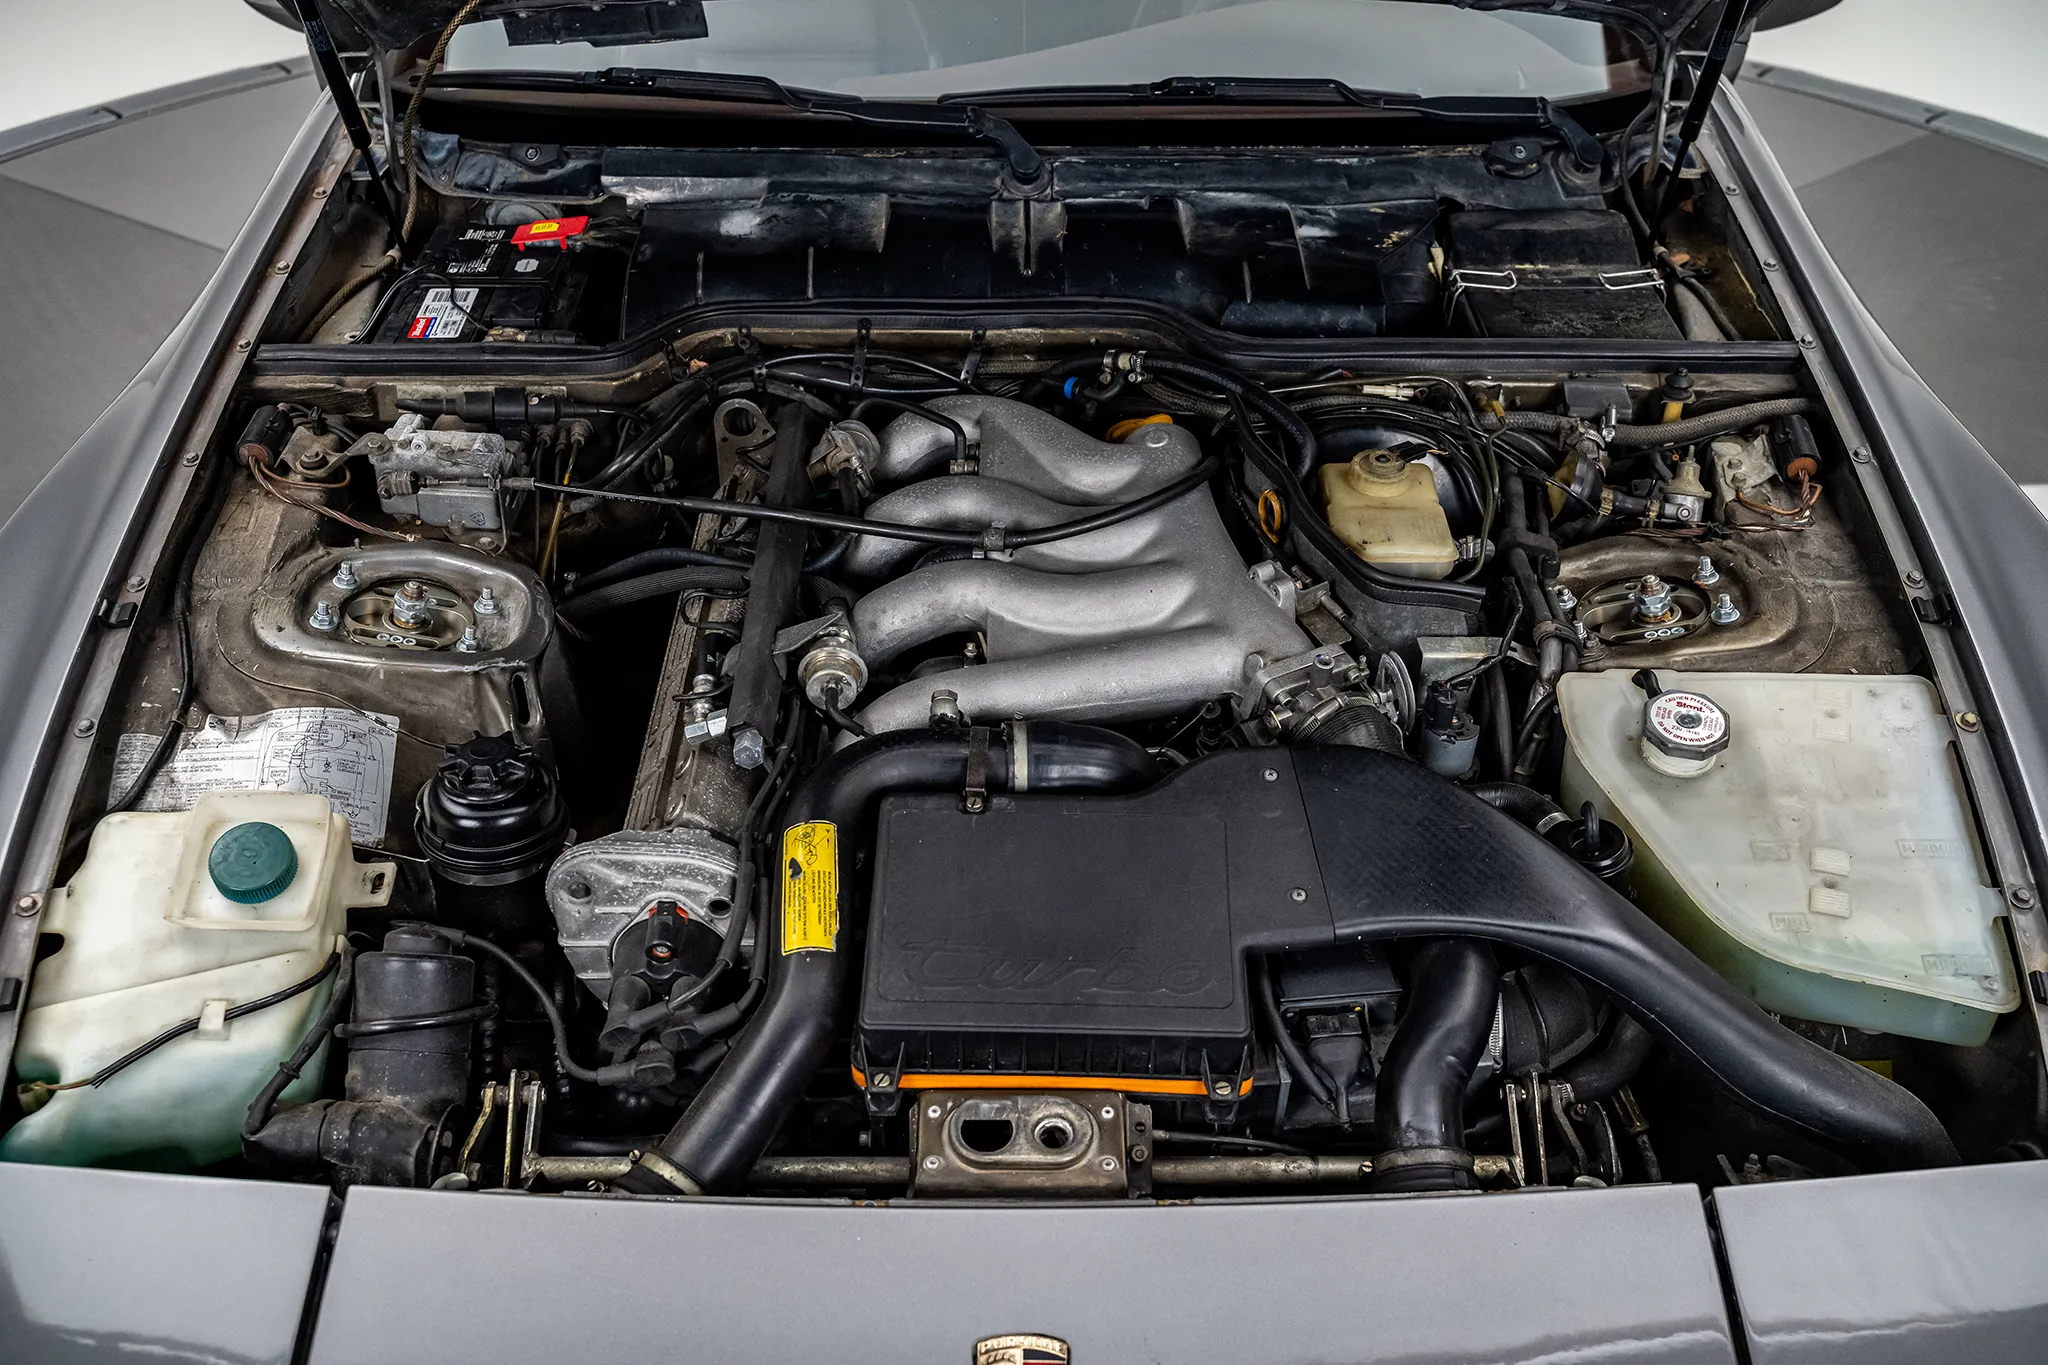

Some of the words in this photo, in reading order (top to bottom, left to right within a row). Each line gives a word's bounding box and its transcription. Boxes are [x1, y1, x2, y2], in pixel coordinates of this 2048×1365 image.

[1676, 701, 1704, 713] Stant
[1663, 727, 1673, 736] NOT
[1672, 734, 1688, 742] OPEN
[981, 1336, 1066, 1353] PORSCHE
